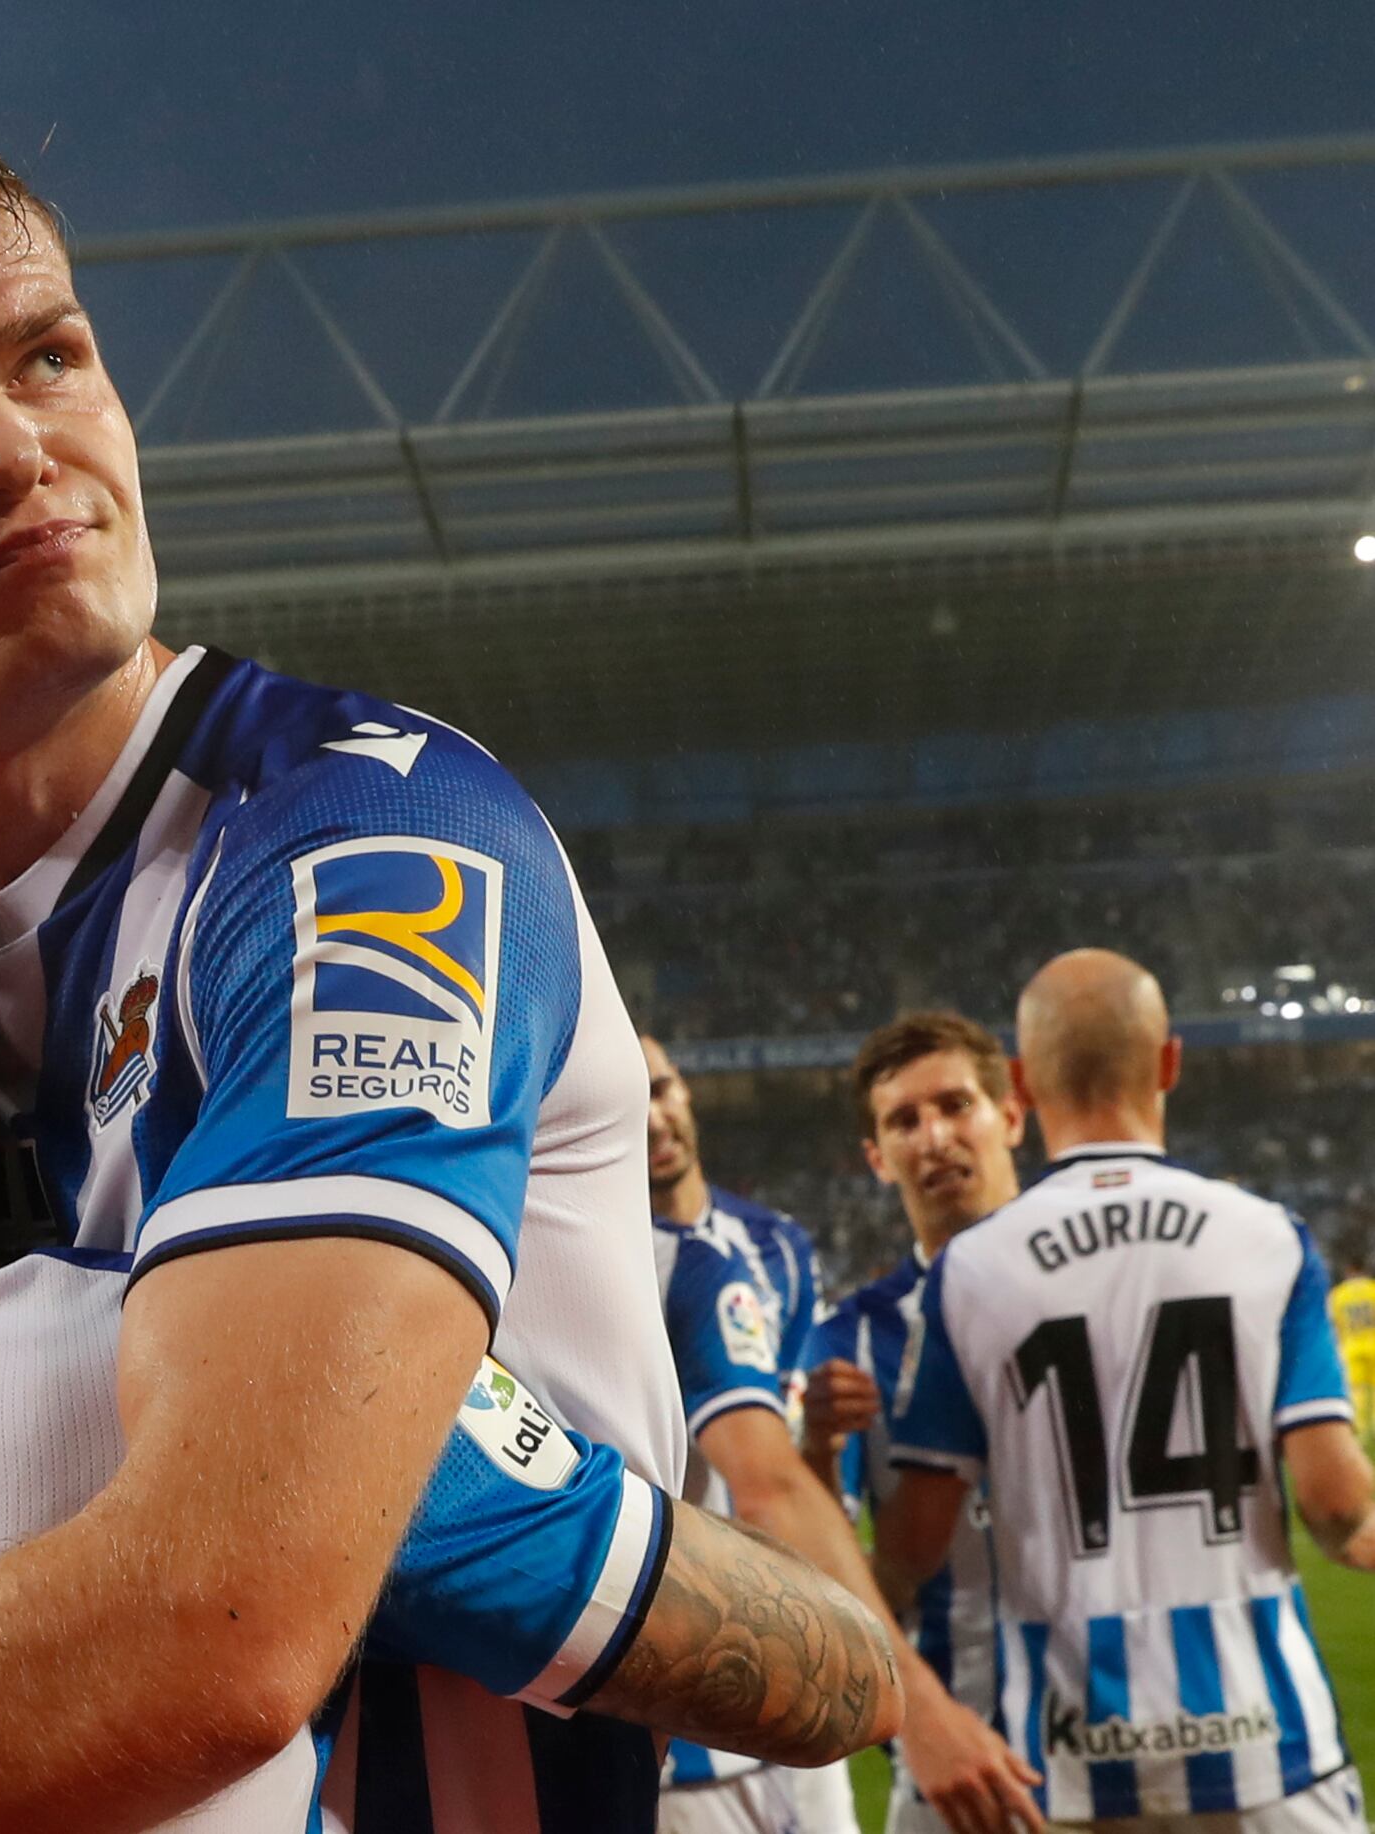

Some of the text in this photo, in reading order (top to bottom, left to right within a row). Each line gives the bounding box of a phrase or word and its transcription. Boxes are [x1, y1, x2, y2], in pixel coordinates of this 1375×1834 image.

[311, 1032, 475, 1086] REALE
[309, 1074, 470, 1114] SEGUROS
[1028, 1199, 1208, 1274] GURIDI
[1004, 1296, 1261, 1560] 14
